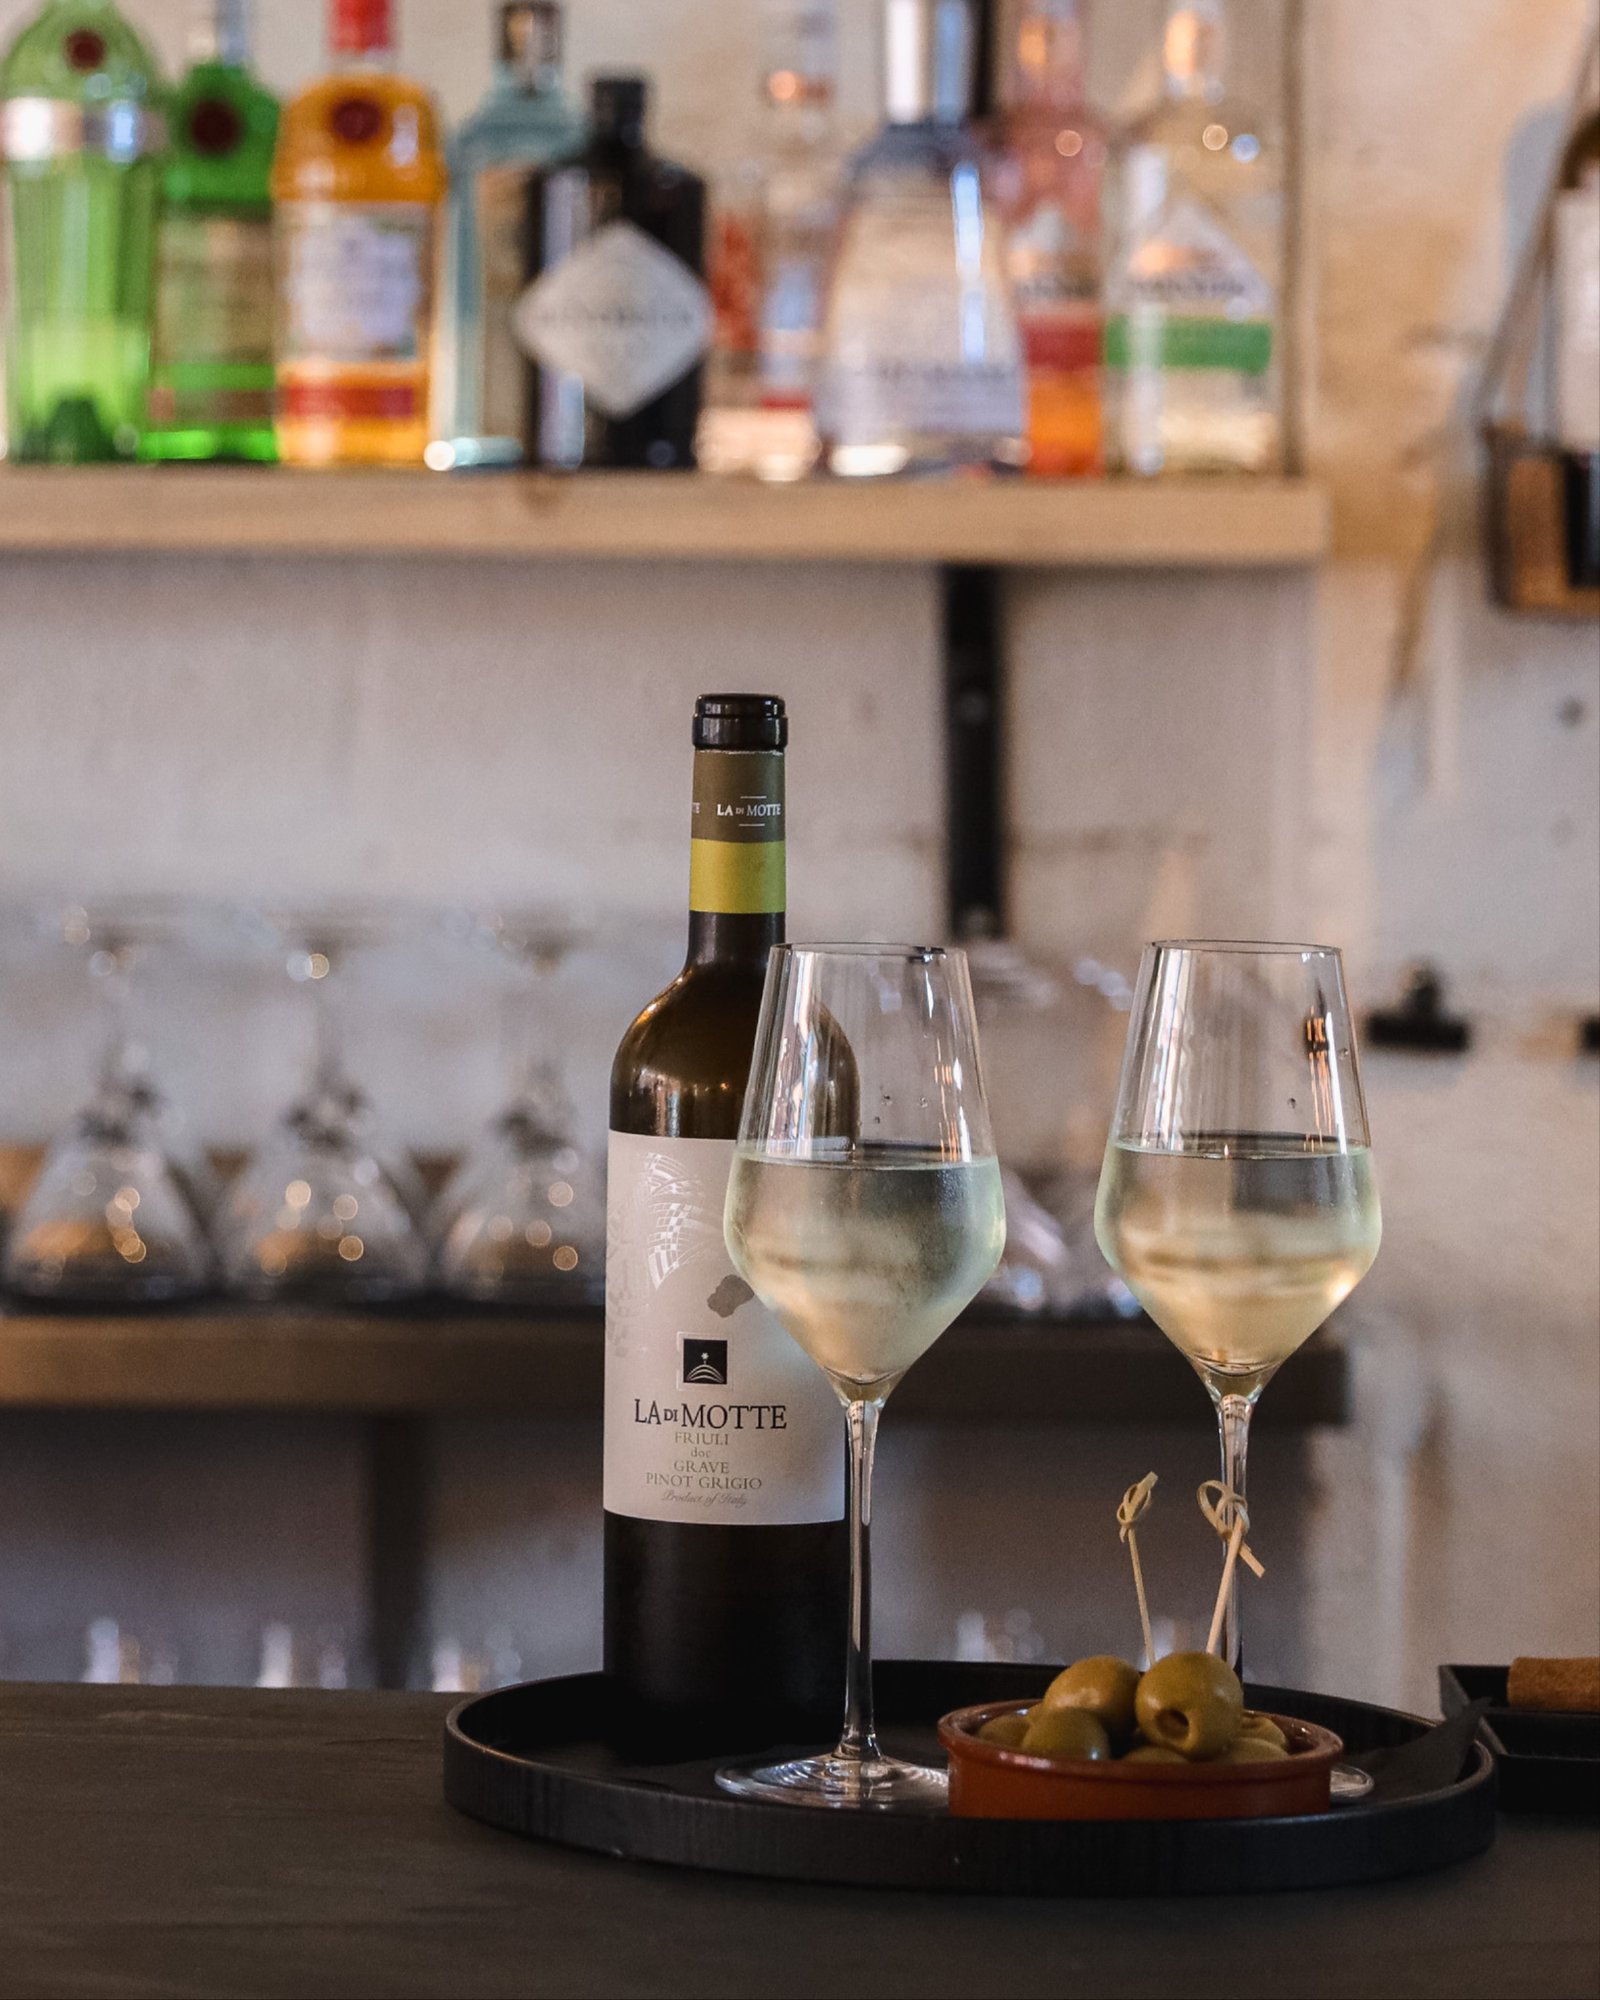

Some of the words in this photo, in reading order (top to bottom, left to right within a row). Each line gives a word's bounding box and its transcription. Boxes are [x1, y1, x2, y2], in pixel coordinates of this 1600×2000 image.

[717, 803, 733, 816] LA
[735, 807, 744, 815] DI
[746, 803, 781, 816] MOTTE
[634, 1399, 661, 1425] LA
[664, 1409, 678, 1422] DI
[681, 1403, 787, 1429] MOTTE
[674, 1431, 729, 1446] FRIULI
[691, 1447, 711, 1457] doc
[673, 1460, 730, 1474] GRAVE
[646, 1472, 694, 1488] PINOT
[698, 1476, 763, 1490] GRIGIO
[662, 1489, 704, 1502] Product
[703, 1493, 719, 1508] of
[719, 1492, 747, 1508] Italy
